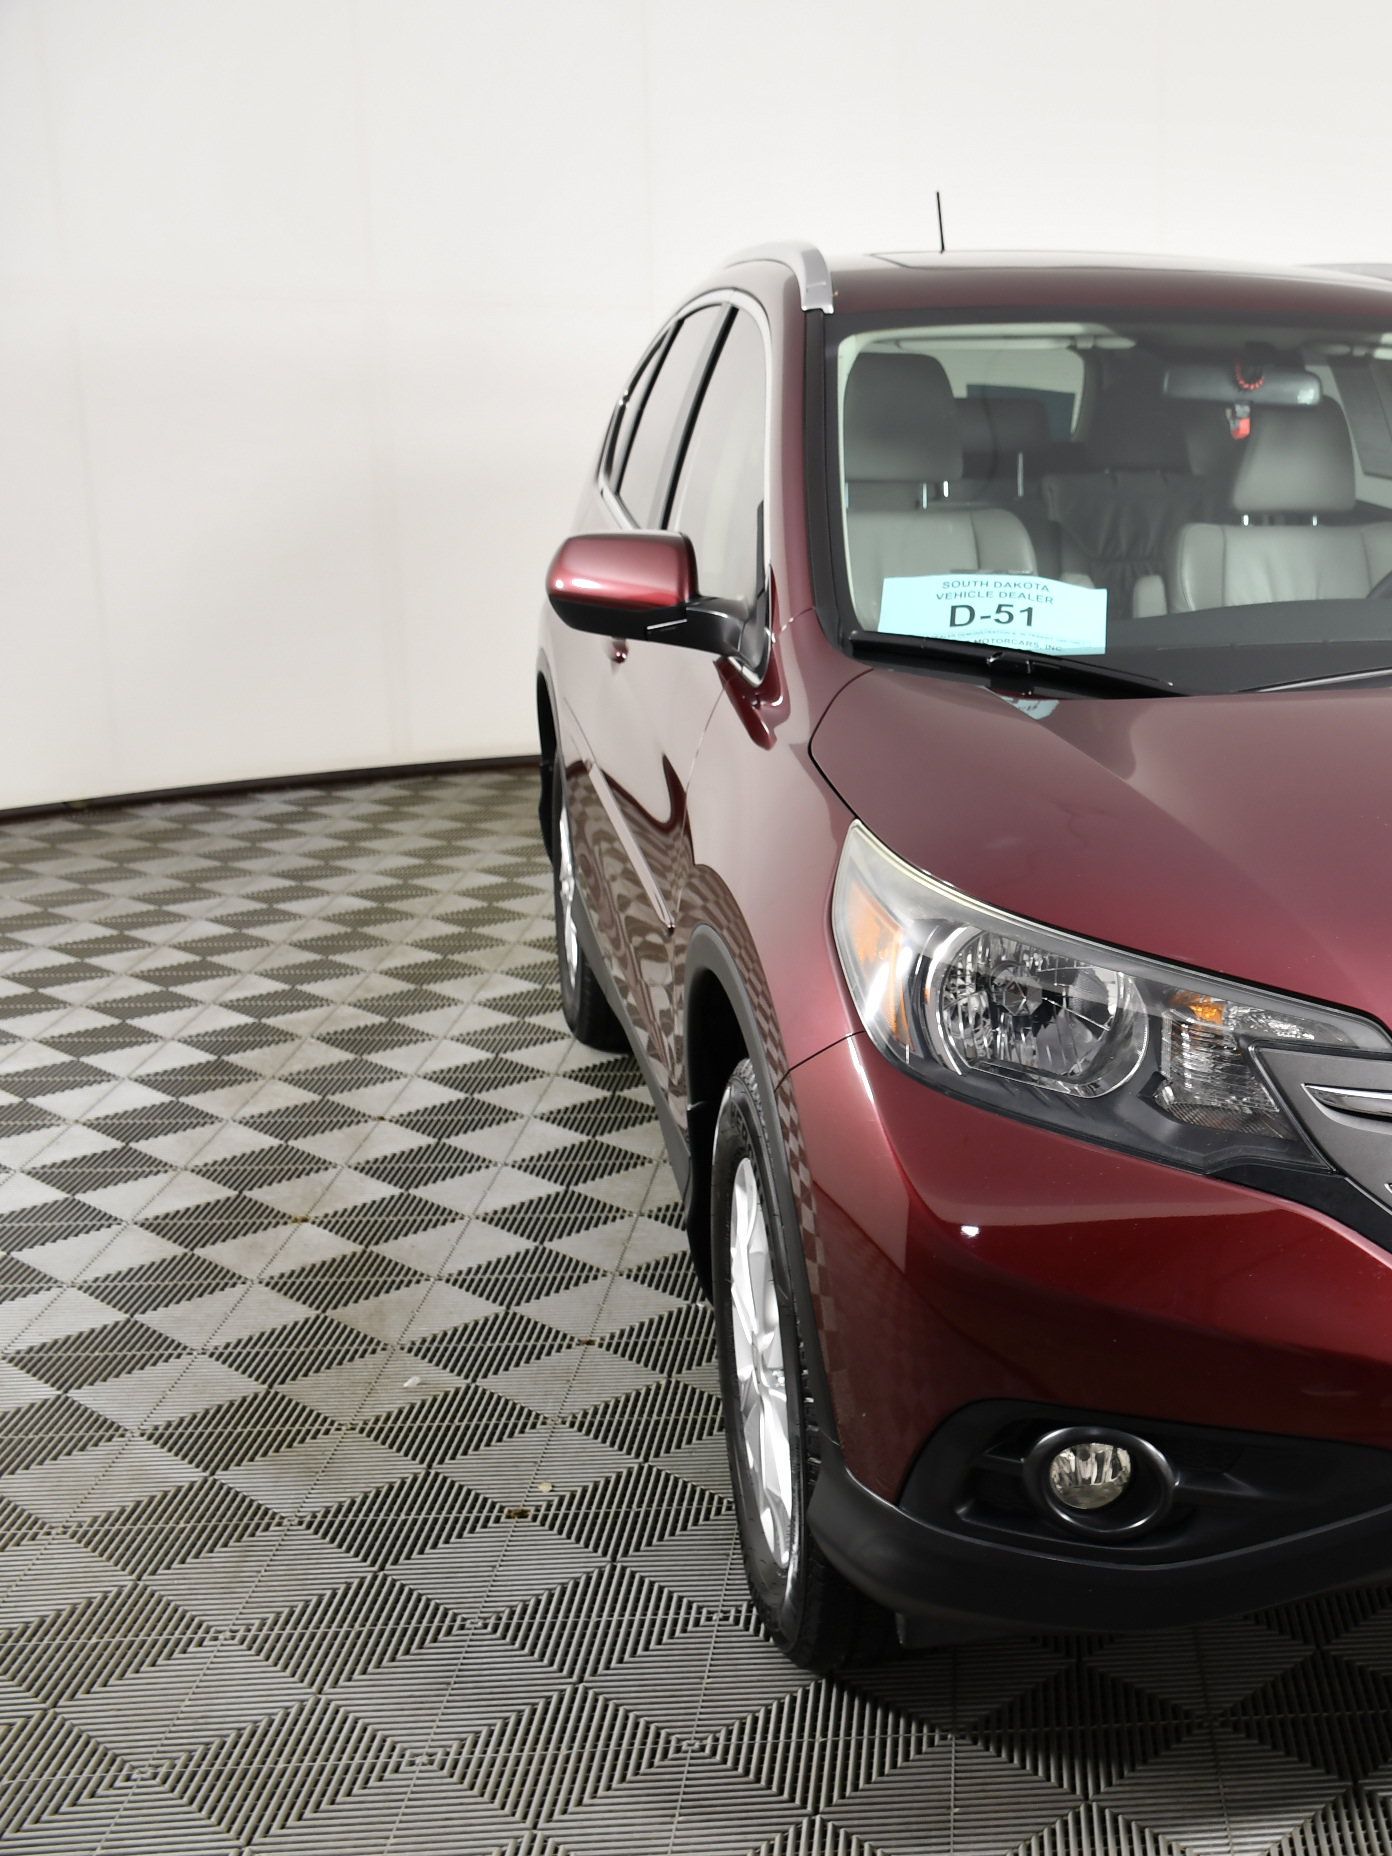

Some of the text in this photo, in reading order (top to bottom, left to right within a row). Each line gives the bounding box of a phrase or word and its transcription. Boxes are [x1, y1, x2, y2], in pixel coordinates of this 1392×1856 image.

[942, 580, 1050, 592] SOUTH DAKOTA
[936, 590, 1054, 604] VEHICLE DEALER
[949, 603, 1034, 628] D-51
